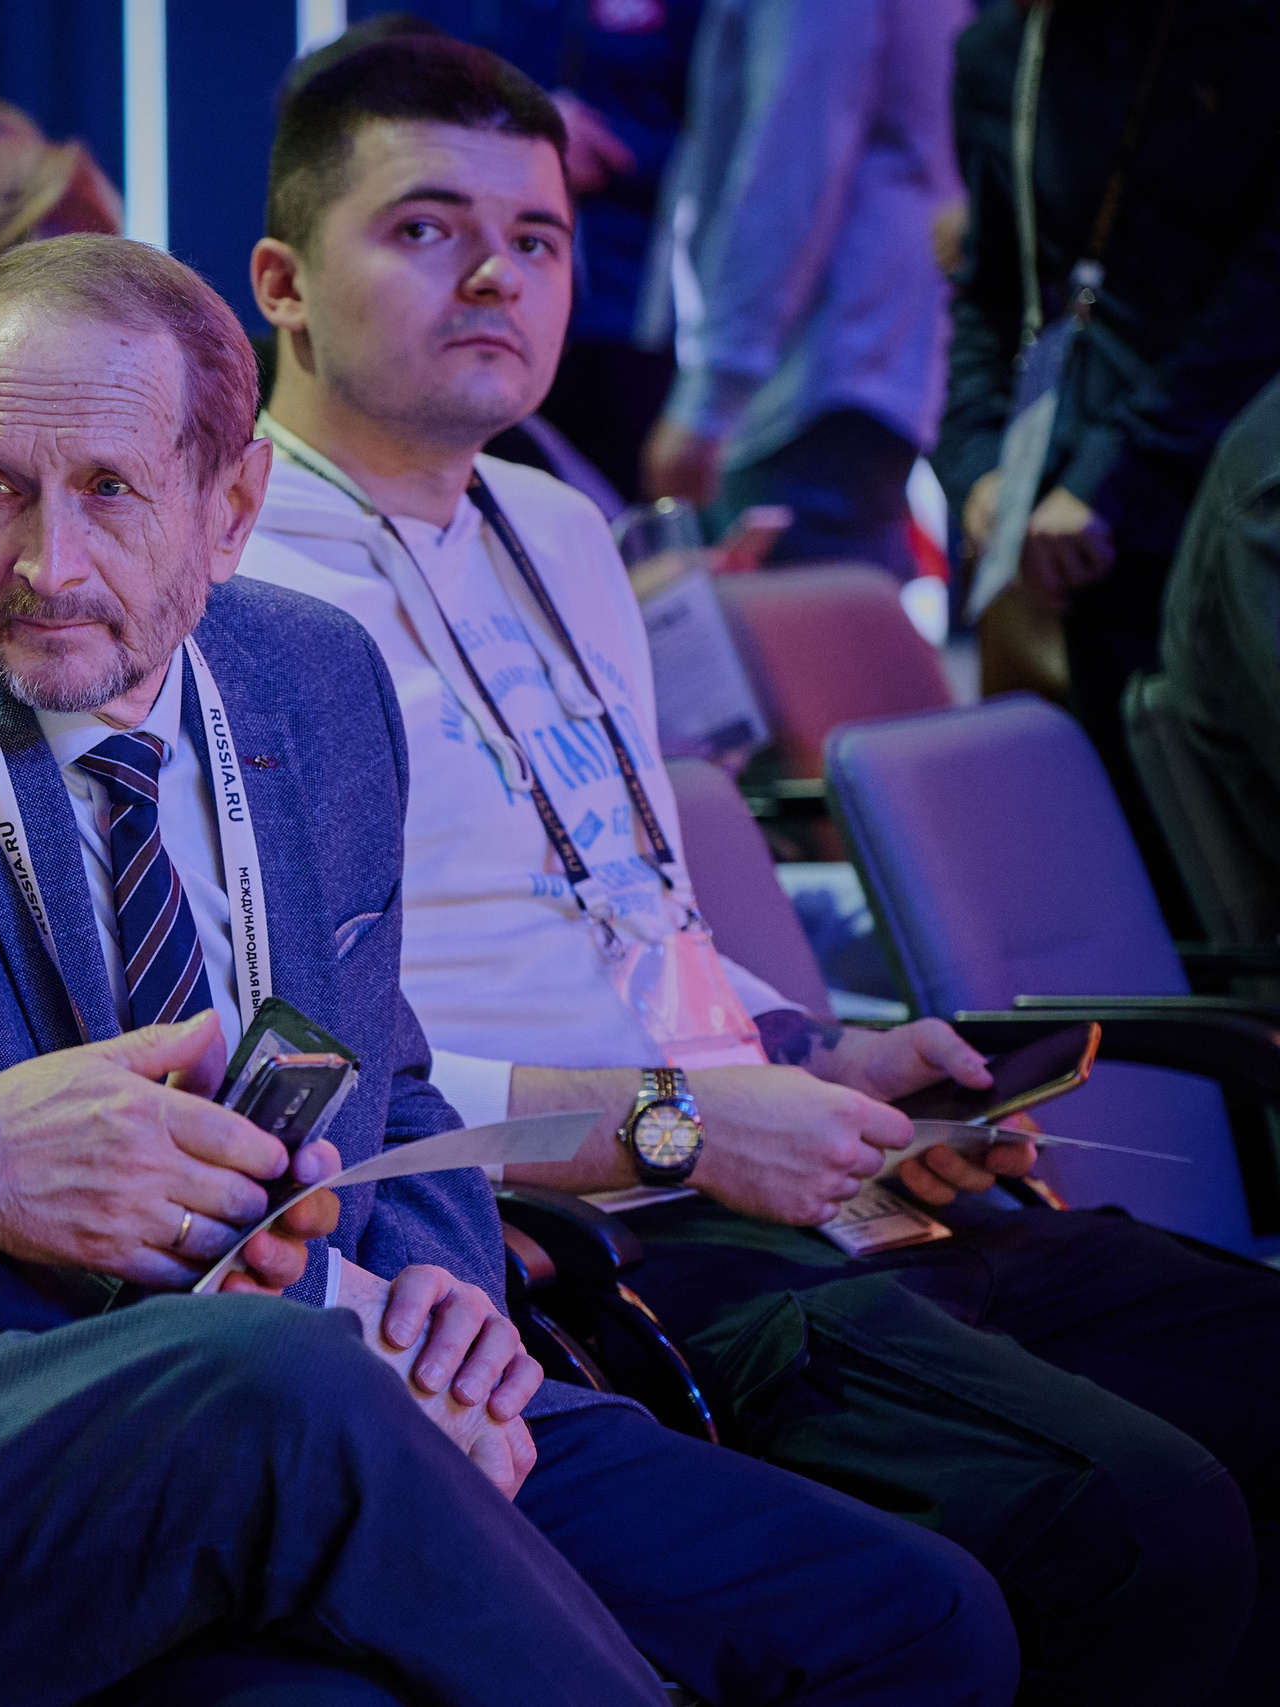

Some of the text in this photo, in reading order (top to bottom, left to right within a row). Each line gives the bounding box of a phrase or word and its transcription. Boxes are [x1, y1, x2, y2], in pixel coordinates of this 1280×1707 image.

[209, 708, 244, 823] RUSSIA.RU
[0, 821, 48, 936] RUSSIA.RU
[238, 866, 260, 988] МЕЖДУНАРОДНАЯ
